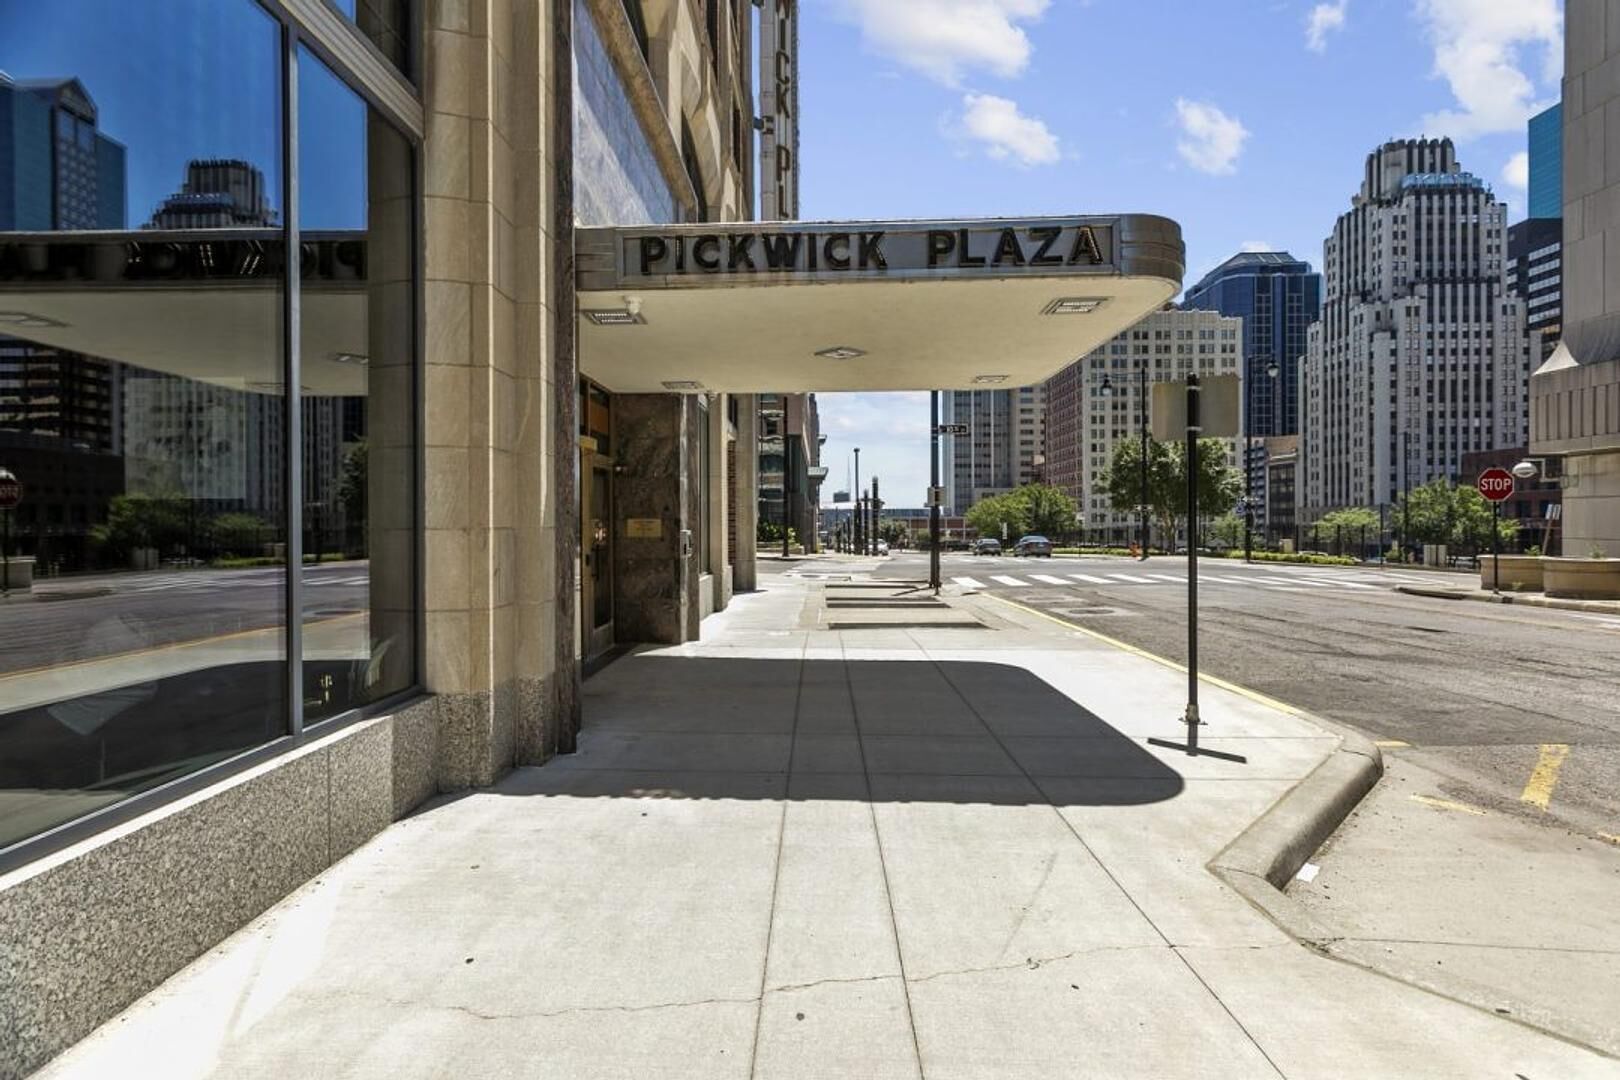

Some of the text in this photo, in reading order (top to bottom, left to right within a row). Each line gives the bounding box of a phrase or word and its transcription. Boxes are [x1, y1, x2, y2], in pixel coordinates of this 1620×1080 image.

[640, 225, 1104, 275] PICKWICK PLAZA
[1480, 478, 1512, 491] STOP
